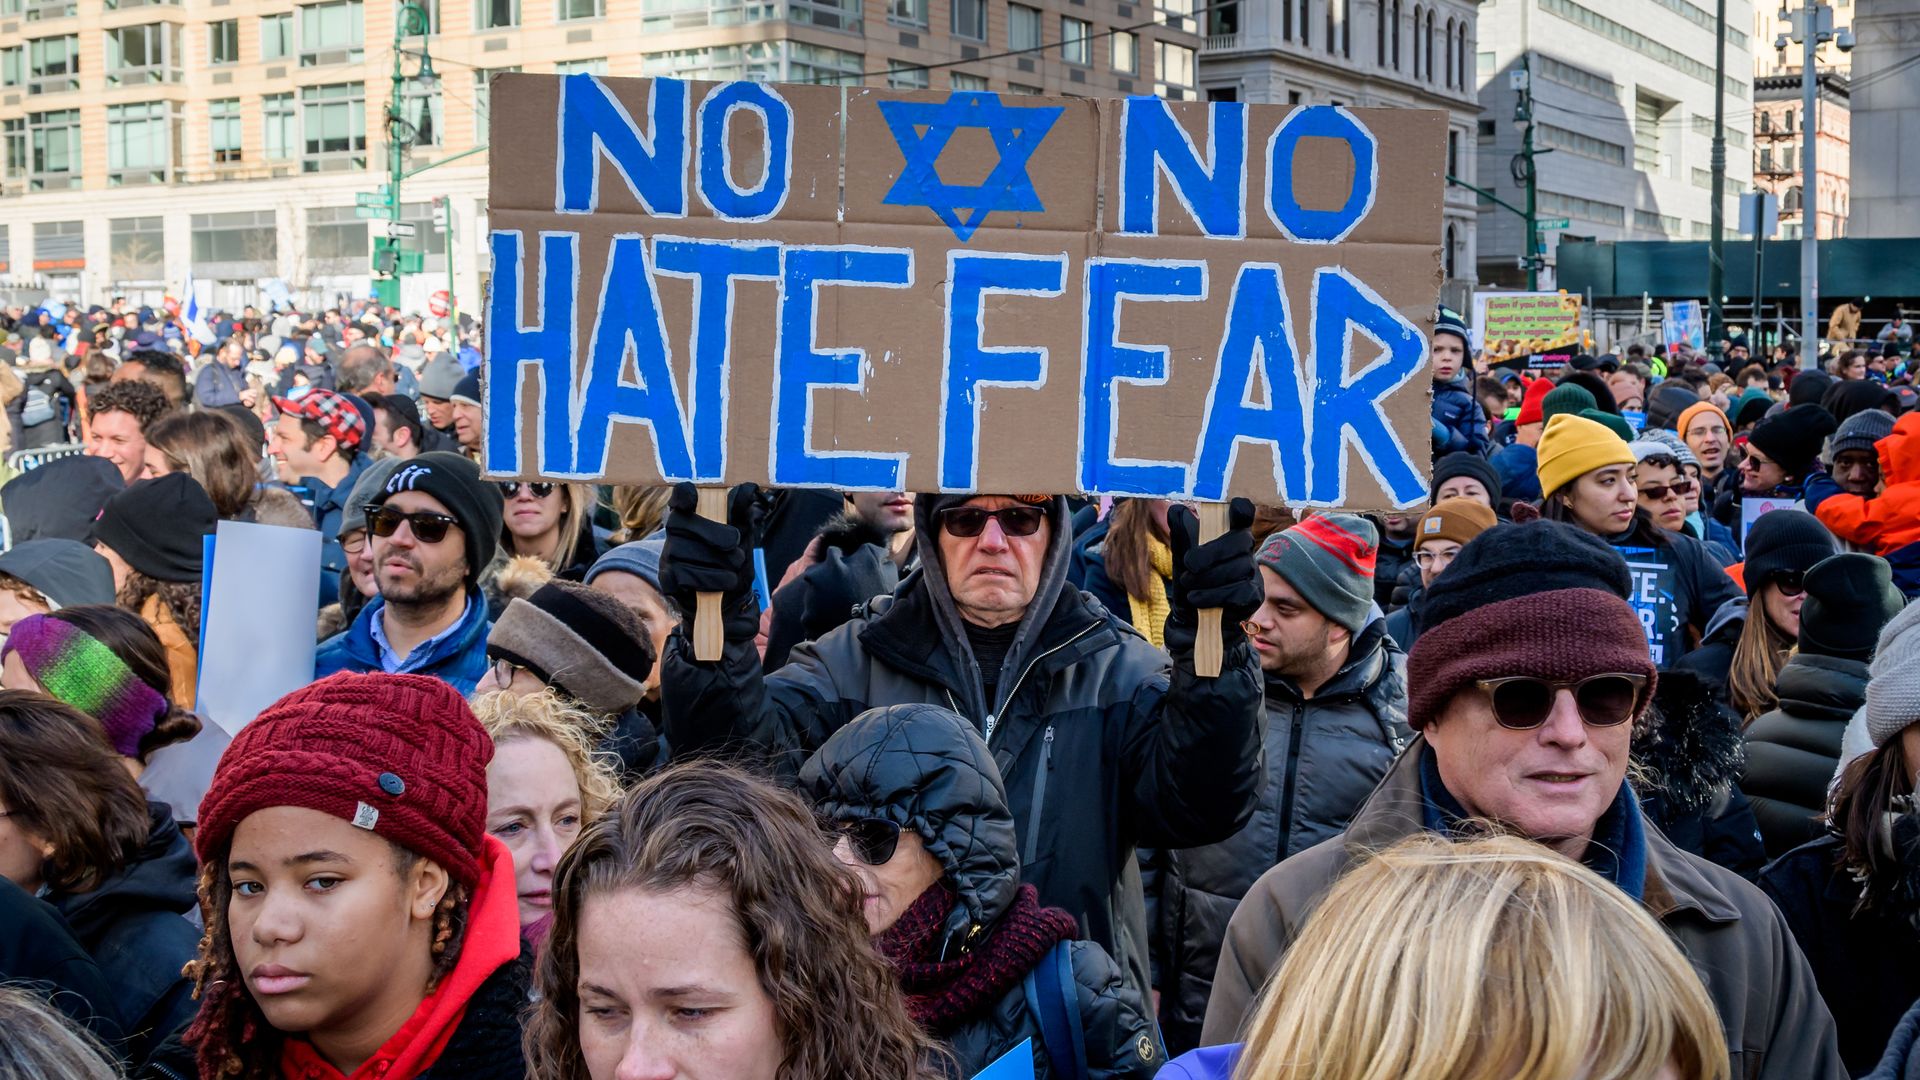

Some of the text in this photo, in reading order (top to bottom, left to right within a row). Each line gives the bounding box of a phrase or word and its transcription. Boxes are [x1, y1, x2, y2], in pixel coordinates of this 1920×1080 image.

[555, 73, 794, 223] NO
[1116, 94, 1379, 245] NO
[483, 229, 915, 493] HATE
[938, 249, 1431, 510] FEAR
[1488, 328, 1500, 336] for
[1489, 301, 1510, 309] Even
[1512, 300, 1518, 308] if
[1537, 300, 1559, 308] think
[1628, 571, 1666, 604] TE.
